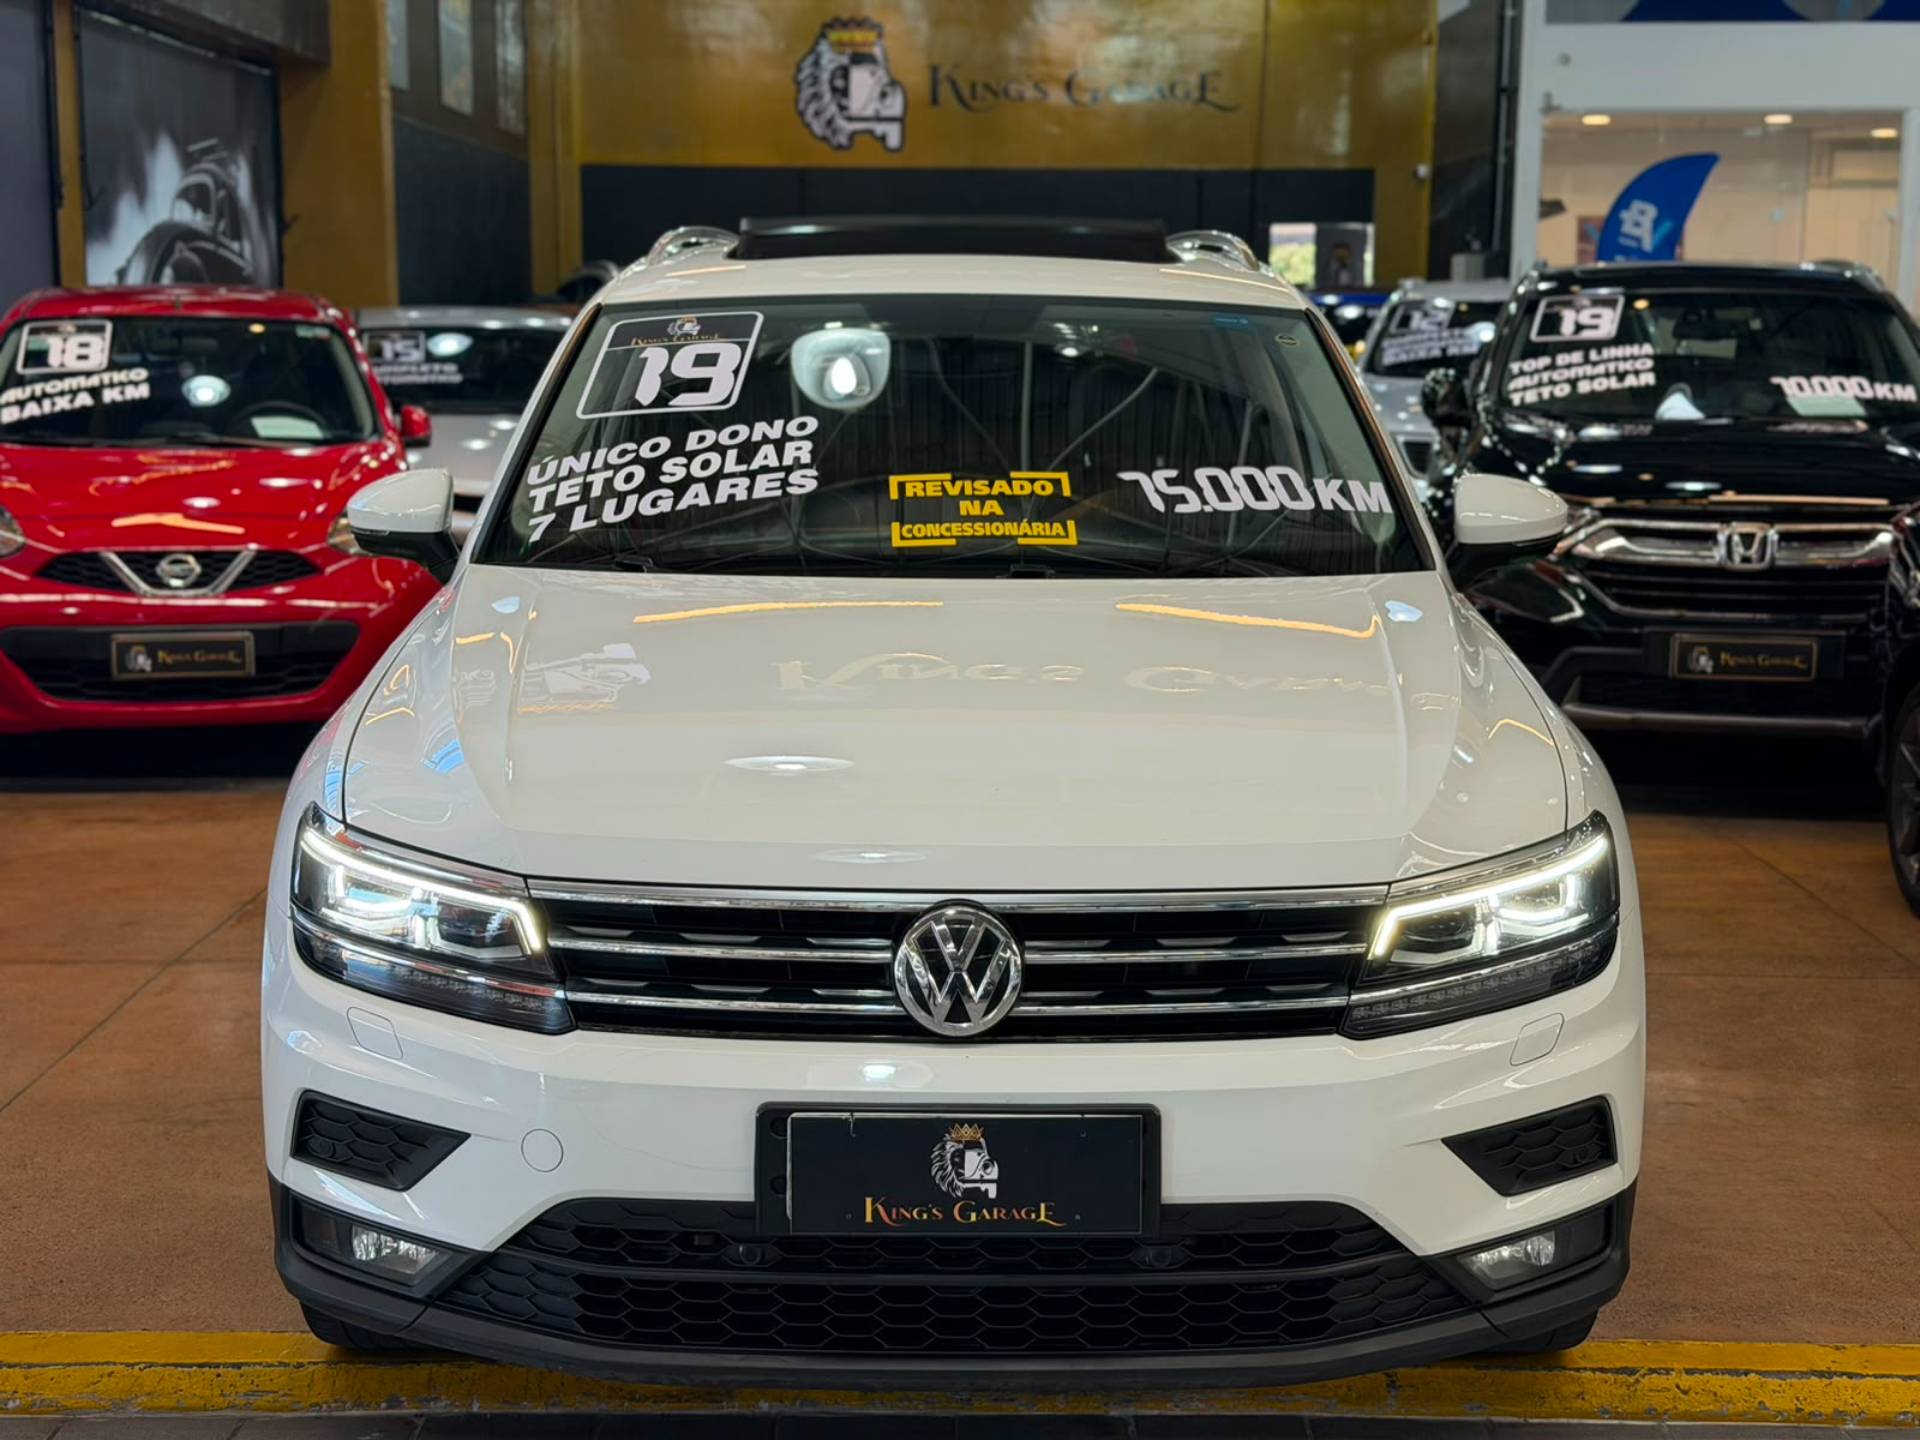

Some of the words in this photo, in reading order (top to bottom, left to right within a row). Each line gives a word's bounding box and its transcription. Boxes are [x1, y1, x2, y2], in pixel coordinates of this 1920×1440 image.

[1560, 307, 1616, 338] 19
[46, 334, 105, 368] 18
[1509, 356, 1551, 375] TOP
[1555, 350, 1584, 367] DE
[1589, 343, 1655, 361] LINHA
[635, 342, 742, 407] 19
[1509, 383, 1572, 407] TETO
[1576, 371, 1656, 394] SOLAR
[0, 391, 95, 425] BAIXA
[102, 382, 151, 404] KM
[527, 436, 671, 485] ÚNICO
[685, 416, 819, 451] DONO
[529, 465, 646, 513] TETO
[659, 441, 813, 483] SOLAR
[905, 480, 1054, 497] REVISADO
[528, 513, 556, 543] 7
[569, 469, 819, 532] LUGARES
[960, 500, 1004, 516] NA
[901, 518, 1066, 538] CONCESSIONÁRIA
[953, 1200, 1067, 1227] GARAGE
